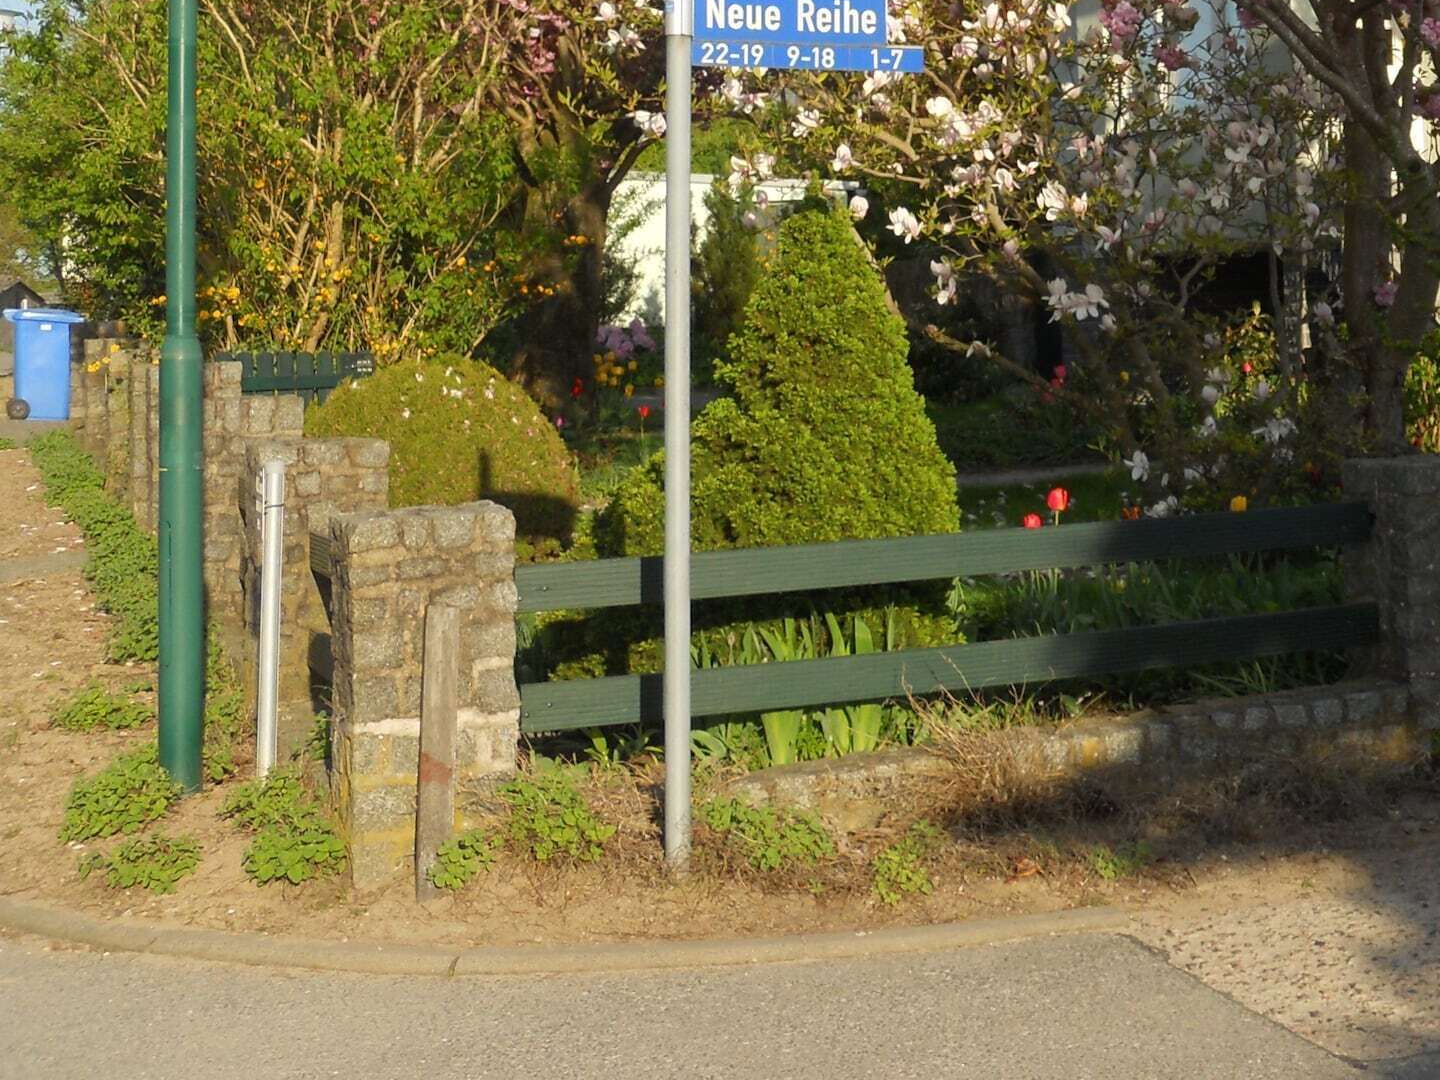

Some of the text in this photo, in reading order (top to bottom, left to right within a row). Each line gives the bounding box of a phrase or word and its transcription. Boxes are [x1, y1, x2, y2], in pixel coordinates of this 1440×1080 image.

[701, 42, 904, 70] 22-19 9-18 1-7
